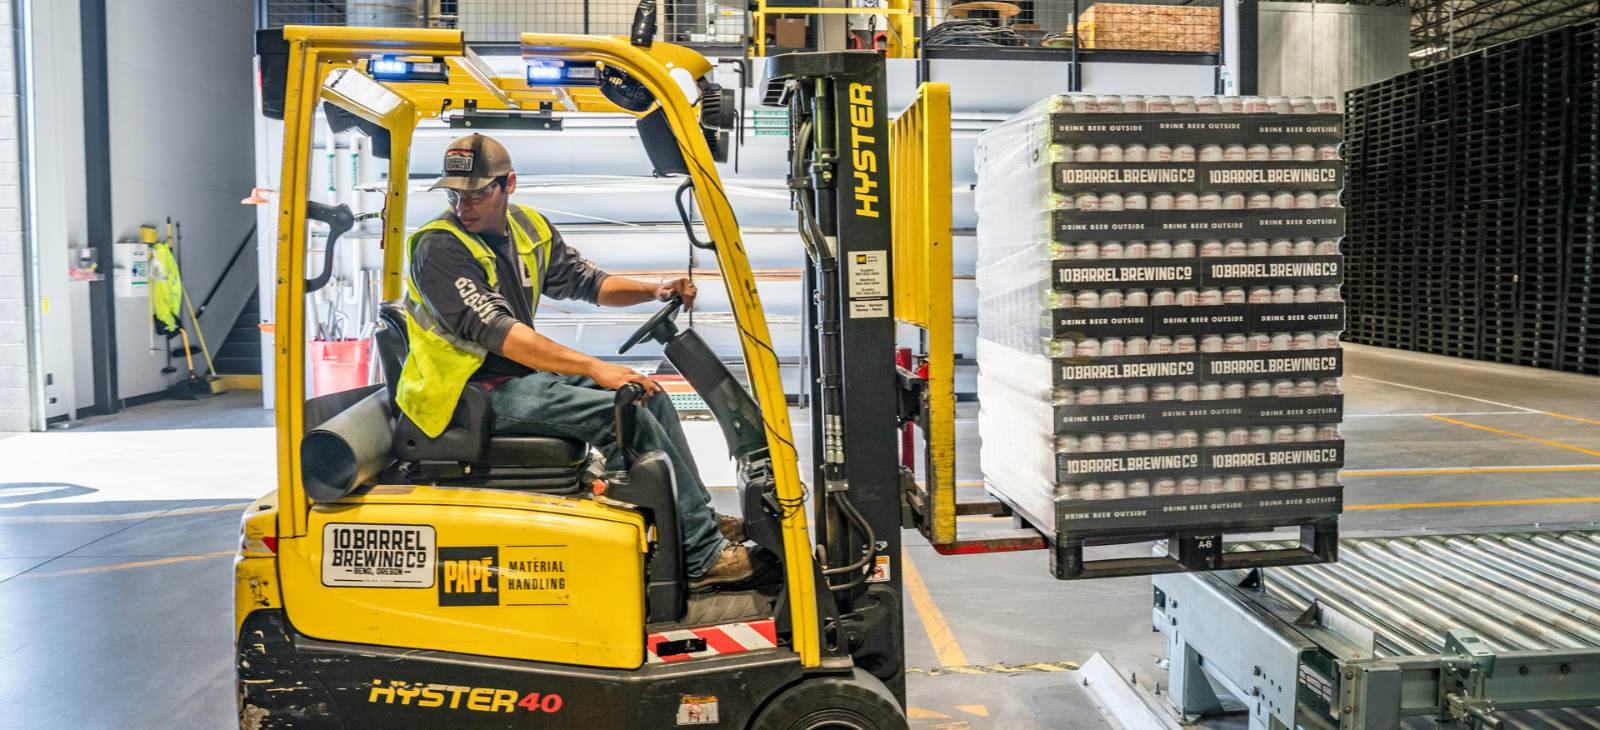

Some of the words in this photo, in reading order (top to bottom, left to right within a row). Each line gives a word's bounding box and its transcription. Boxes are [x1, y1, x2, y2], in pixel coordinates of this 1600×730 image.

[849, 82, 879, 218] HYSTER
[332, 550, 404, 567] BREWING
[508, 560, 565, 573] MATERIAL
[508, 578, 565, 590] HANDLING
[368, 679, 519, 713] HYSTER
[517, 692, 563, 713] 40
